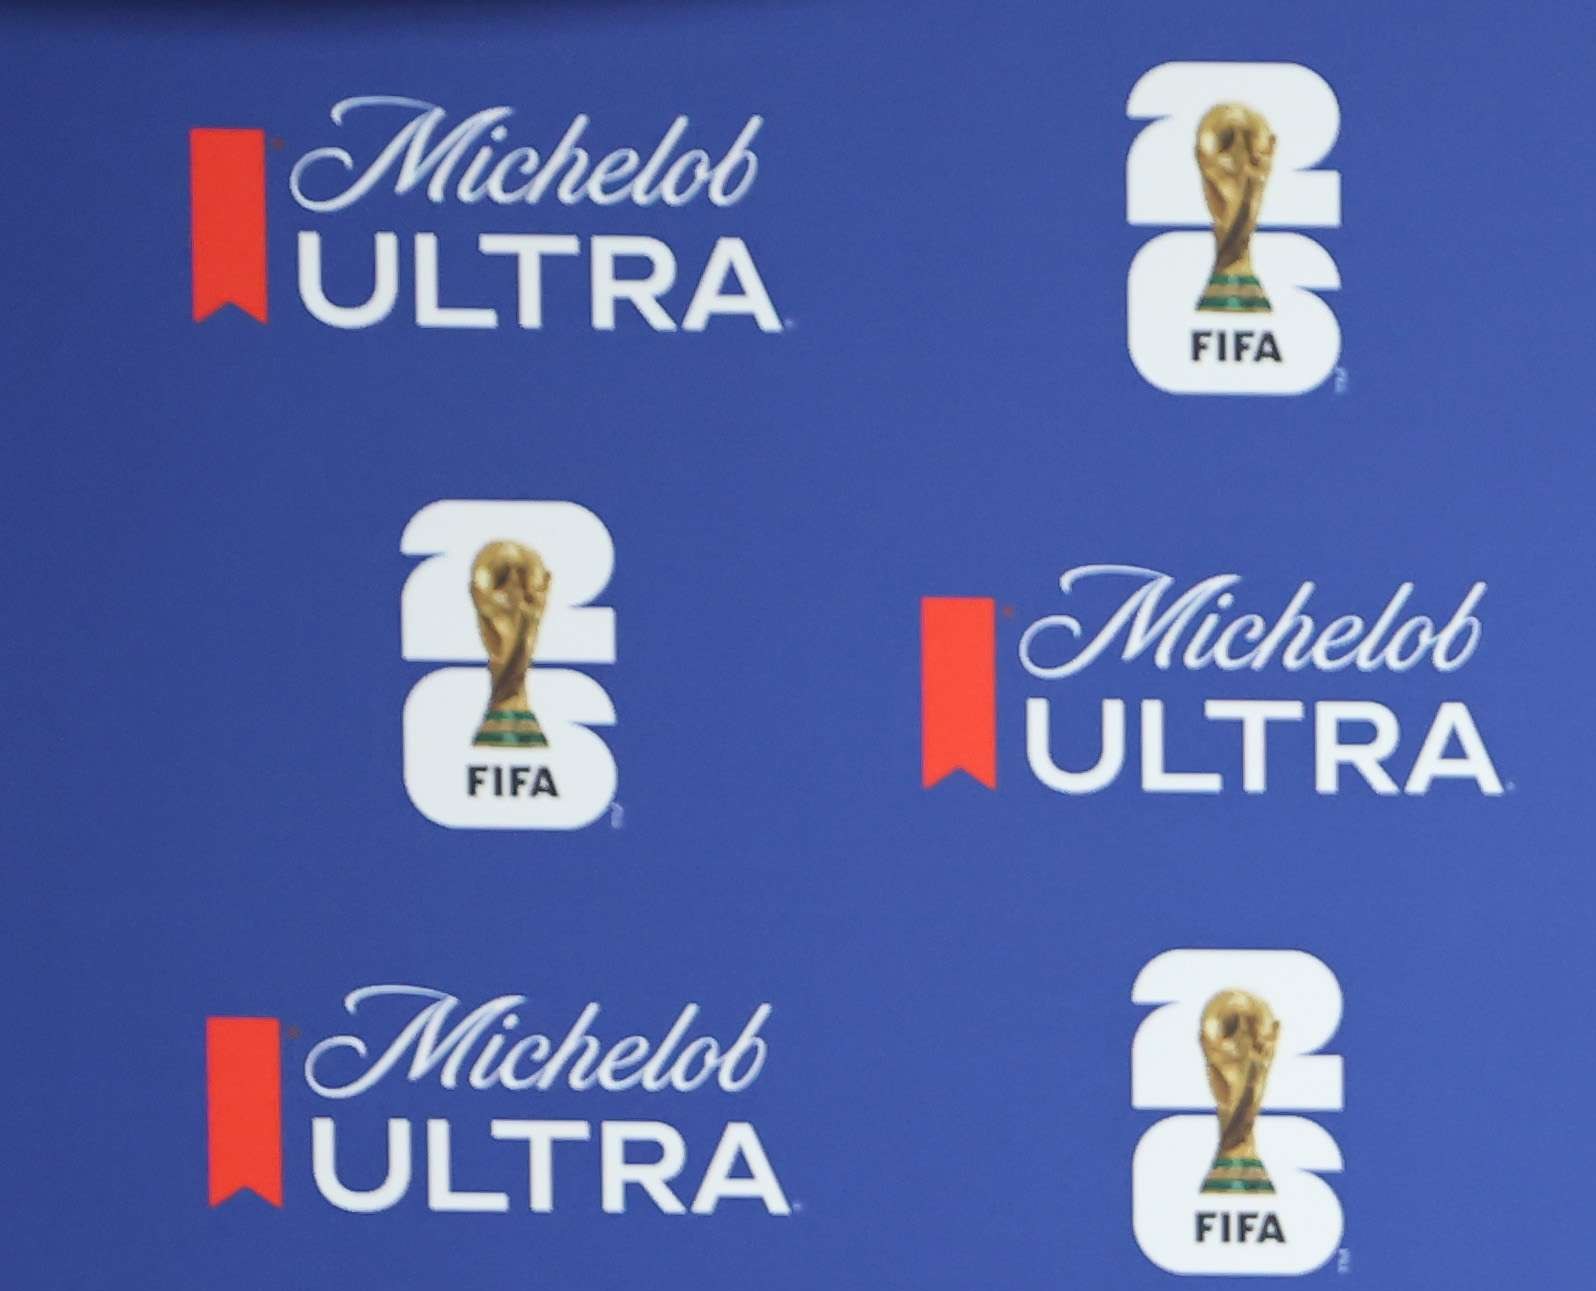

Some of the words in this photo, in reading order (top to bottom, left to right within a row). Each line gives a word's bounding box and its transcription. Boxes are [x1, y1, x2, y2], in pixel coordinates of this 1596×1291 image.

[290, 96, 762, 211] Michelob
[298, 231, 782, 332] ULTRA
[1194, 333, 1280, 361] FIFA
[1019, 565, 1486, 678] Michelob
[470, 767, 557, 796] FIFA
[1027, 698, 1504, 795] ULTRA
[305, 985, 772, 1098] Michelob
[312, 1118, 790, 1215] ULTRA
[1198, 1214, 1284, 1242] FIFA
